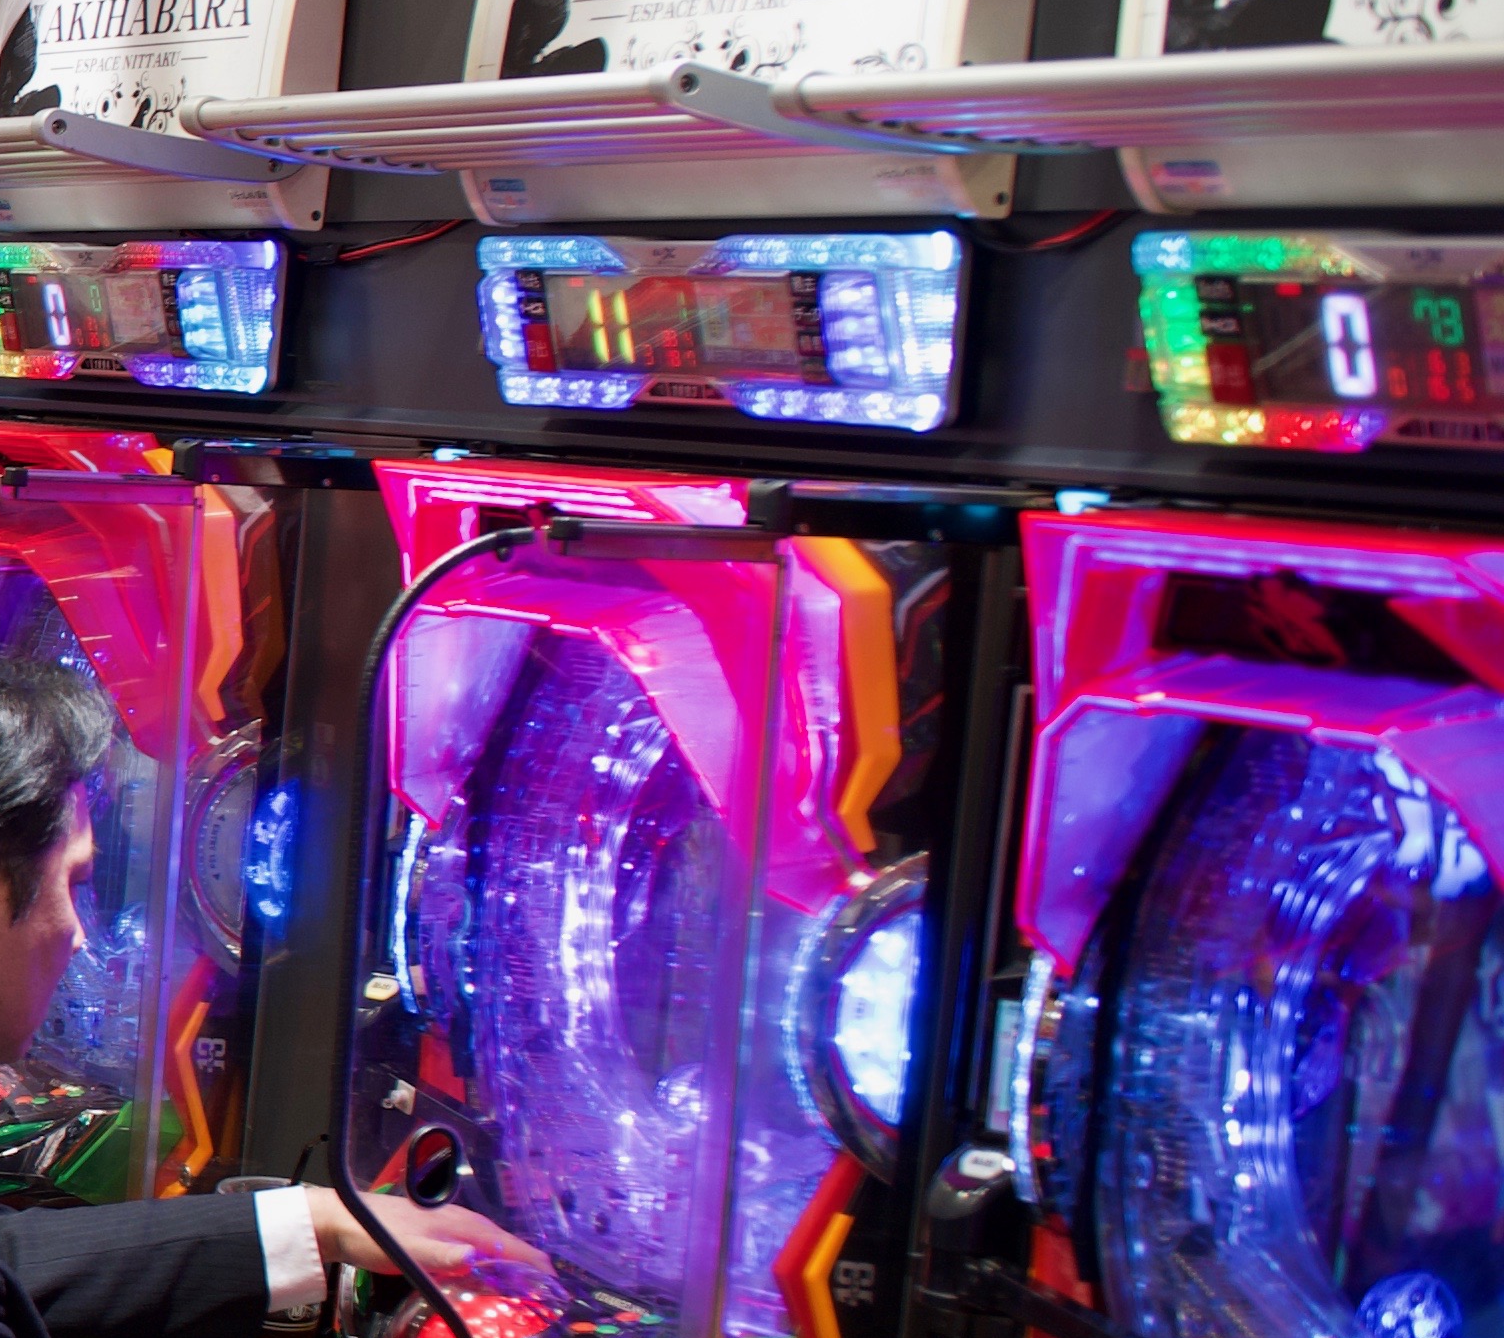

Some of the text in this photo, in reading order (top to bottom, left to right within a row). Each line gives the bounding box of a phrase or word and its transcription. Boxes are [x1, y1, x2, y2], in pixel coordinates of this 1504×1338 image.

[74, 51, 181, 74] ESPACE NITTAKU
[44, 283, 72, 346] 0
[1322, 293, 1377, 397] 0
